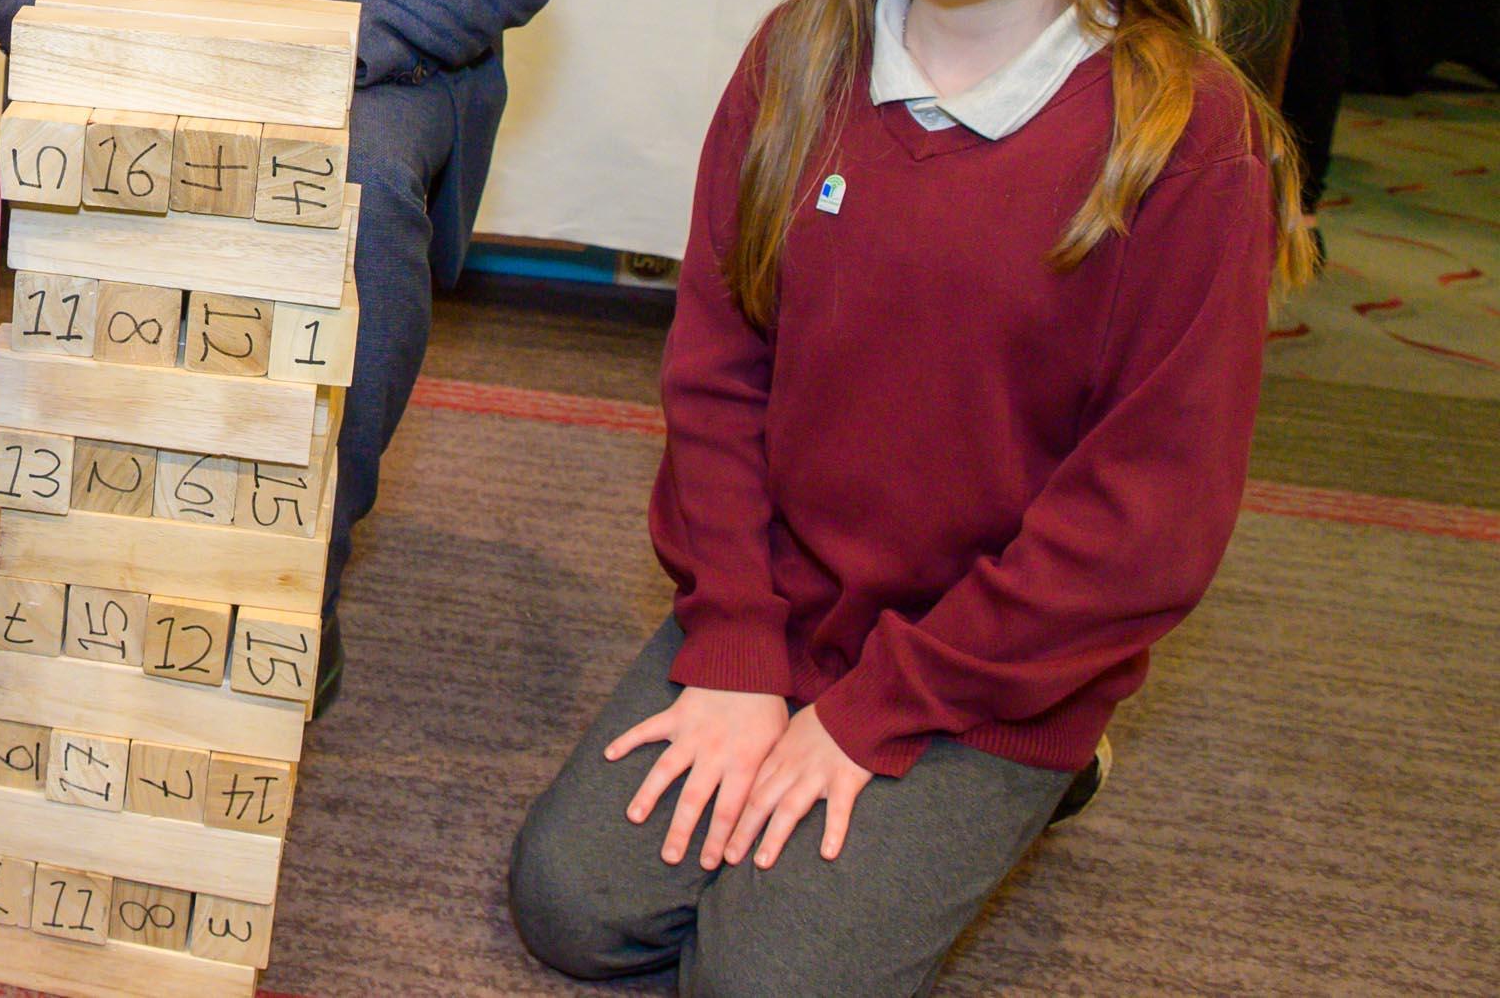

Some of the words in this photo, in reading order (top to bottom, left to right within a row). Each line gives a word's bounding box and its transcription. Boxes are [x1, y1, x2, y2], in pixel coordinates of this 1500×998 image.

[11, 144, 68, 190] 5
[92, 136, 158, 197] 16
[180, 145, 248, 192] 4
[271, 155, 334, 215] 14
[22, 290, 84, 342] 11
[107, 311, 163, 345] 8
[200, 302, 262, 362] 12
[294, 320, 326, 366] 1
[86, 457, 142, 493] 2
[173, 455, 216, 518] 6
[250, 462, 308, 527] 15
[3, 602, 34, 644] 7
[77, 600, 128, 659] 15
[154, 617, 213, 674] 12
[245, 631, 308, 688] 15
[59, 742, 111, 802] 17
[139, 769, 194, 800] 7
[221, 773, 279, 825] 14
[42, 880, 94, 931] 11
[119, 901, 176, 932] 8
[208, 917, 252, 943] 3
